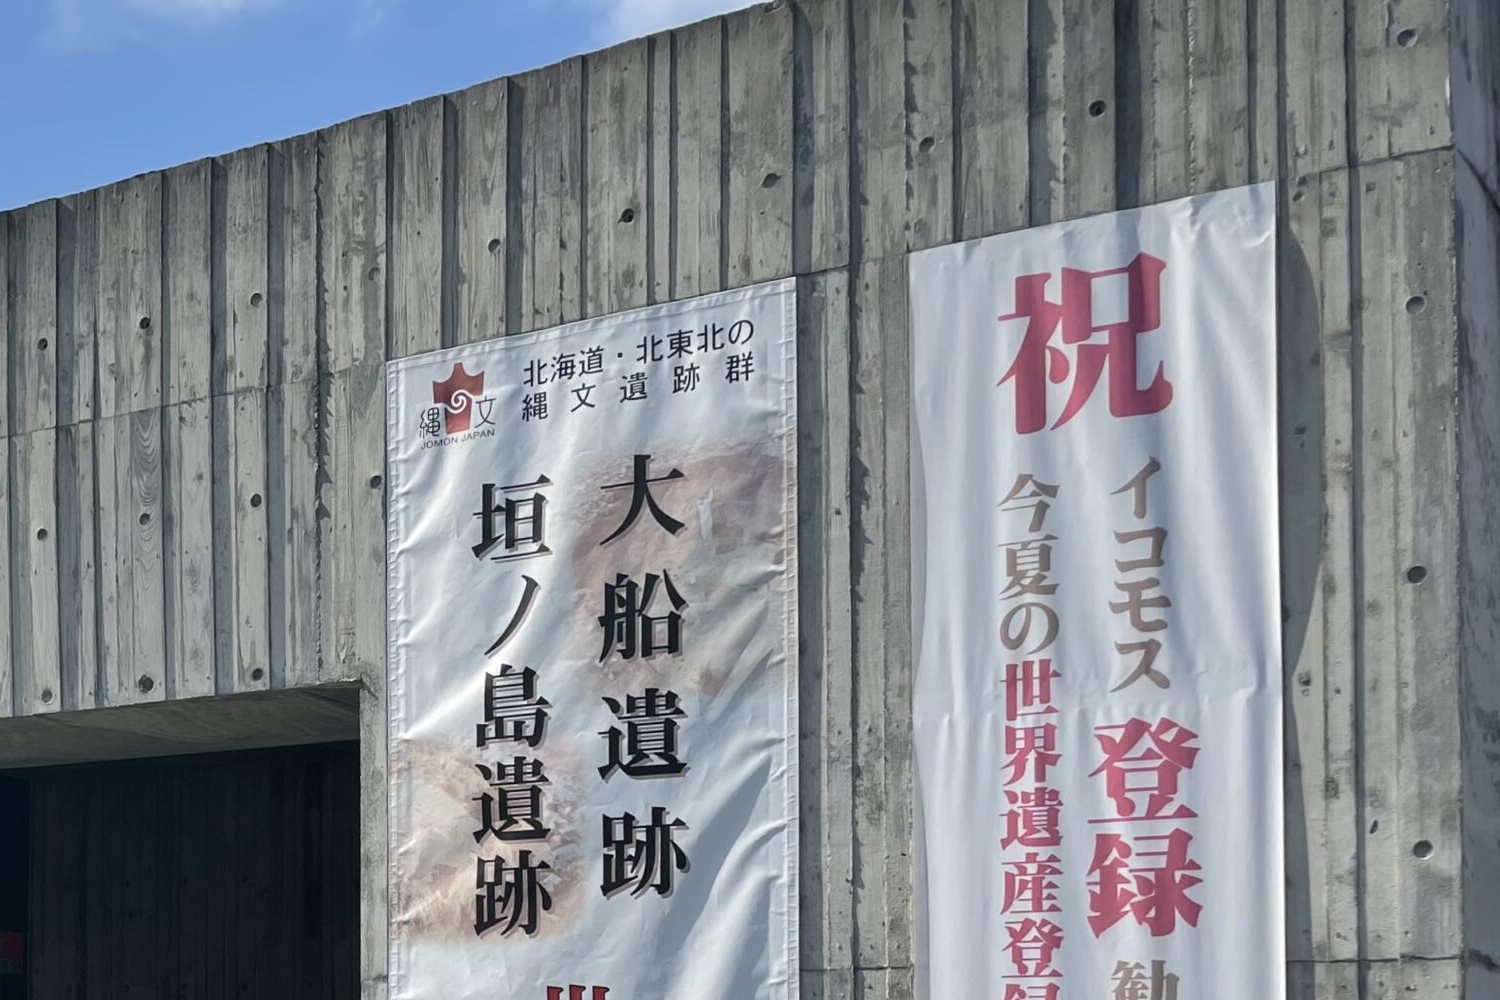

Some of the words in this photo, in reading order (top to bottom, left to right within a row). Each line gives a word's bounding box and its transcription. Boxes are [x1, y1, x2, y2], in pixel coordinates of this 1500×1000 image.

[521, 350, 755, 422] 縄文遺跡群
[522, 318, 755, 387] 北海道・北東北の
[996, 252, 1173, 434] 祝
[420, 436, 458, 450] JOMON
[461, 428, 495, 442] JAPAN
[471, 473, 553, 937] 垣ノ島遺跡
[597, 453, 689, 898] 大船遺跡
